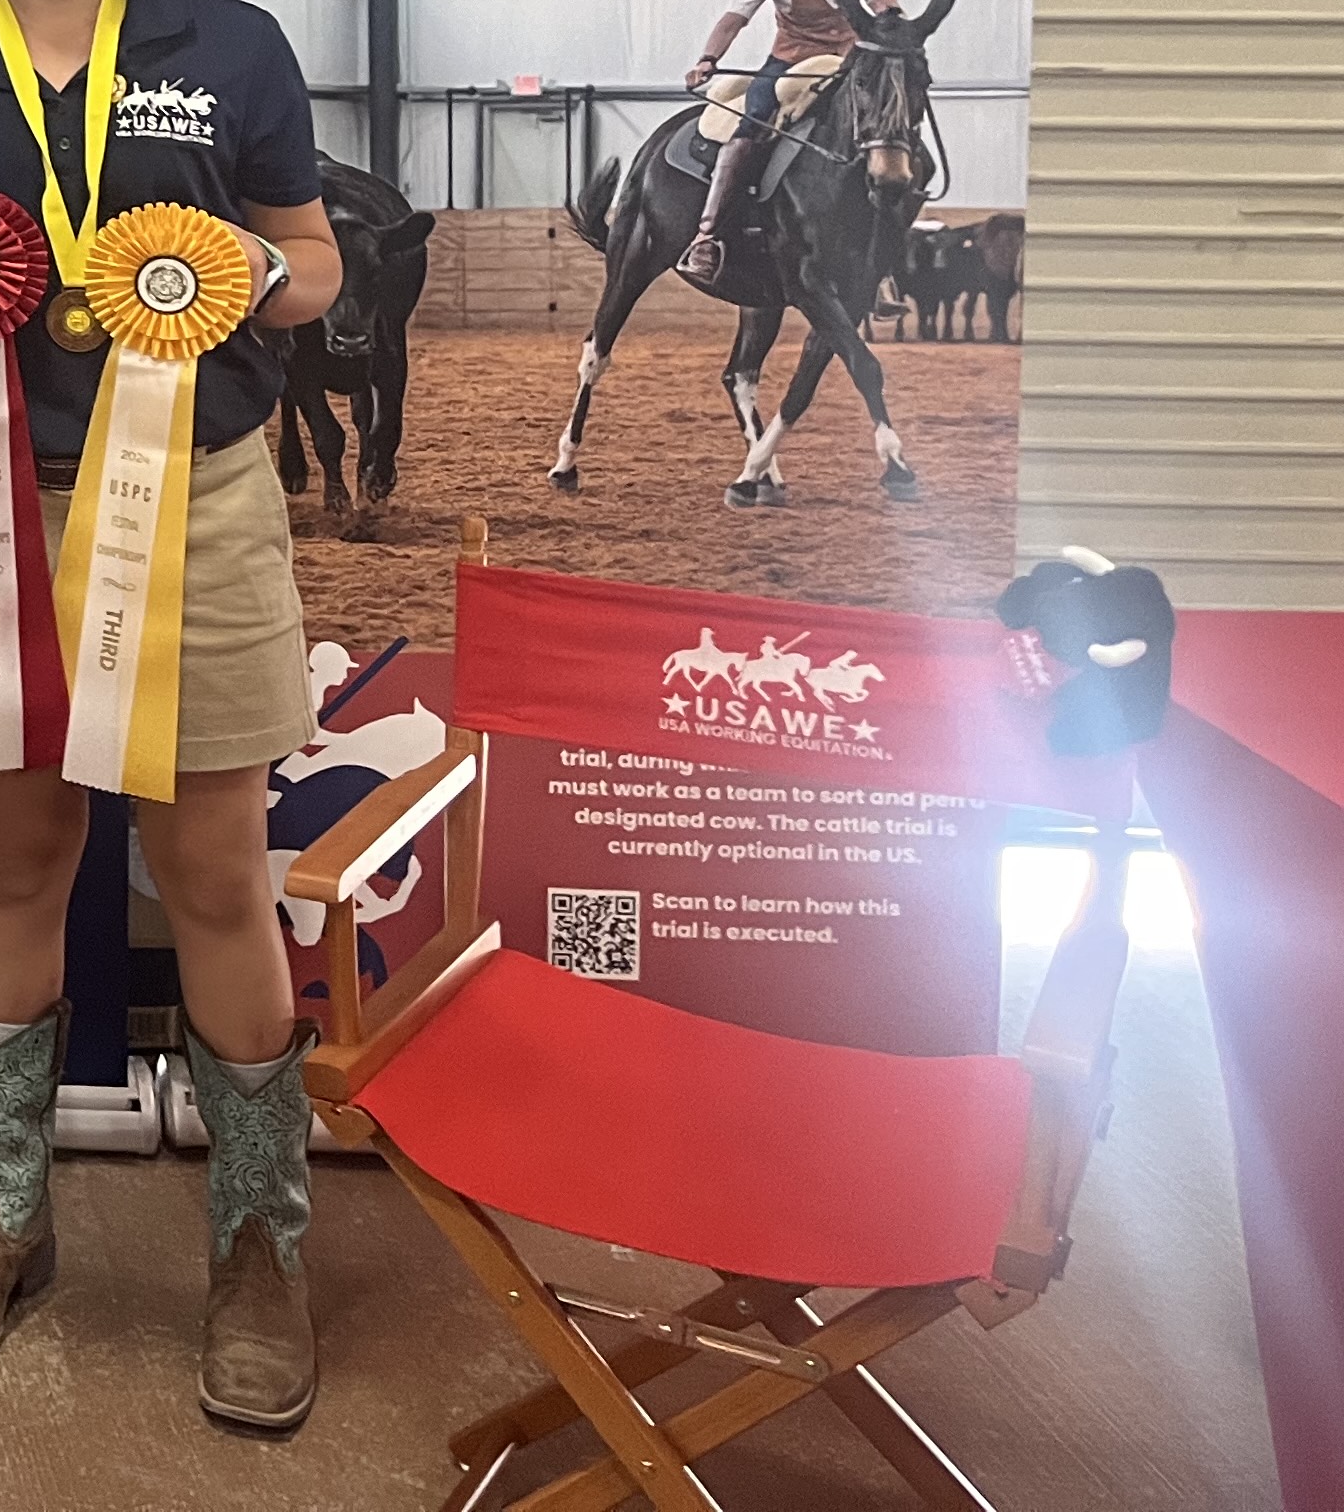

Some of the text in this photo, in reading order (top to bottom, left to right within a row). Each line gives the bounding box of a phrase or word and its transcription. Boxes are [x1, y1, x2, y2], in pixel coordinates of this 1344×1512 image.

[133, 115, 202, 136] USAWE
[99, 609, 124, 673] THIRD
[695, 696, 845, 740] USAWE
[659, 717, 884, 760] USA WORKING EQUITATION
[560, 748, 613, 770] trial,
[549, 779, 610, 796] must
[613, 781, 670, 799] work
[674, 785, 702, 799] as
[706, 787, 721, 800] a
[727, 785, 787, 802] team
[792, 787, 815, 803] to
[819, 788, 865, 804] sort
[869, 790, 915, 807] and
[575, 807, 958, 837] designated cow. The cattle trial is
[608, 840, 713, 863] currently
[717, 840, 812, 863] optional
[818, 843, 839, 861] in
[844, 845, 882, 863] the
[652, 892, 901, 916] Scan to learn how this
[652, 920, 839, 944] trial is executed.
